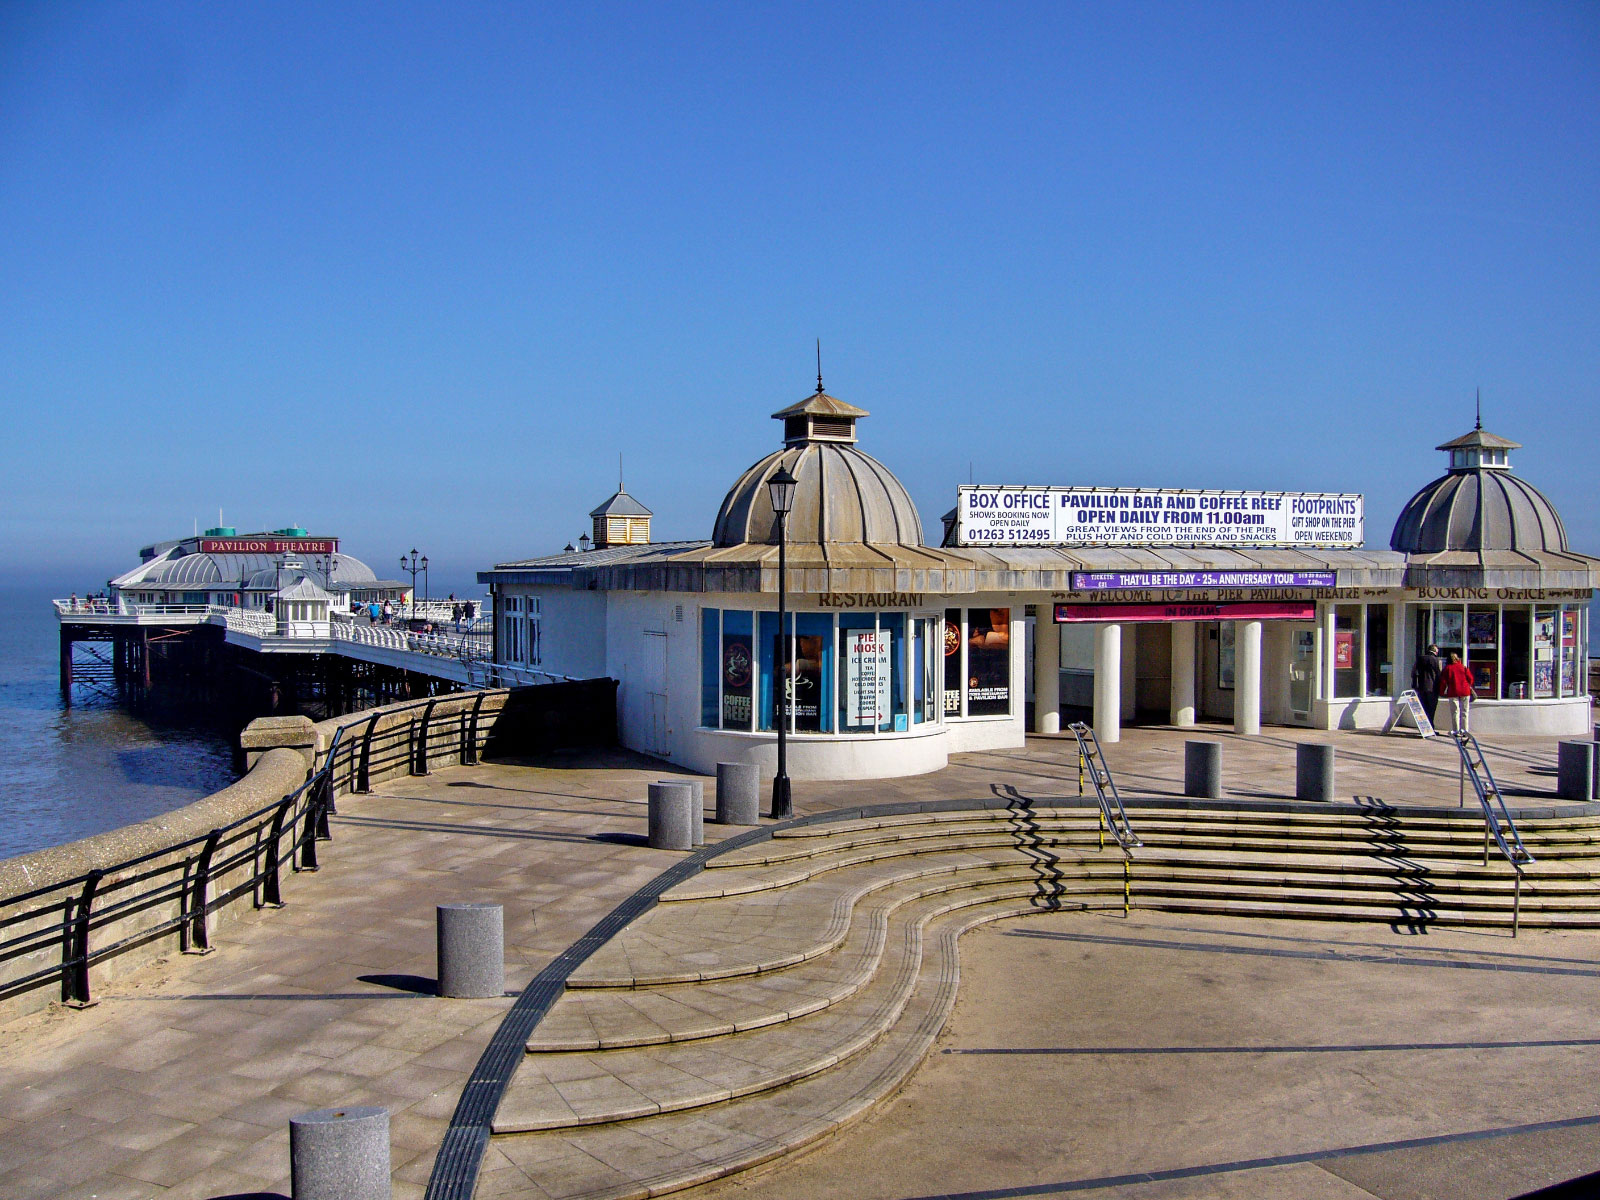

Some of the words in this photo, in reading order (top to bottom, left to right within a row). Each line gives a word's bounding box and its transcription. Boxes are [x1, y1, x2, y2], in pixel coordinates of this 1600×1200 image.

[969, 493, 999, 509] BOX
[1003, 493, 1050, 509] OFFICE
[1061, 494, 1129, 508] PAVILION
[1133, 496, 1163, 509] BAR
[1166, 496, 1196, 509] AND
[1200, 496, 1248, 510] COFFEE
[1252, 498, 1282, 510] REEF
[1292, 498, 1356, 514] FOOTPRINTS
[969, 511, 996, 519] SHOWS
[1077, 510, 1116, 524] OPEN
[1120, 510, 1160, 524] DAILY
[1164, 510, 1203, 524] FROM
[1206, 512, 1264, 524] 11.00am
[1292, 516, 1304, 528] GIFT
[1305, 517, 1320, 528] SHOP
[1322, 518, 1330, 528] ON
[1331, 518, 1342, 528] THE
[1342, 518, 1356, 528] PIER
[968, 528, 1005, 540] 01263
[1008, 529, 1050, 540] 512495
[1294, 530, 1313, 540] OPEN
[1314, 531, 1353, 541] WEEKENDS
[211, 541, 268, 551] PAVILION
[274, 542, 326, 552] THEATRE
[1120, 574, 1150, 586] THAT'LL
[1152, 574, 1162, 585] BE
[1162, 574, 1178, 585] THE
[1179, 574, 1196, 585] DAY
[1219, 574, 1272, 584] ANNIVERSARY
[1274, 574, 1294, 584] TOUR
[1090, 590, 1152, 602] WELCOME
[1217, 588, 1243, 600] PIER
[1310, 588, 1360, 599] THEATRE
[1418, 586, 1488, 598] BOOKING
[1496, 588, 1545, 600] OFFICE
[818, 592, 925, 608] RESTAURANT
[1165, 607, 1176, 616] IN
[1180, 606, 1220, 616] DREAMS
[858, 634, 880, 642] PIE
[854, 644, 885, 653] KIOSK
[724, 695, 750, 706] COFFEE
[723, 705, 750, 721] REEF
